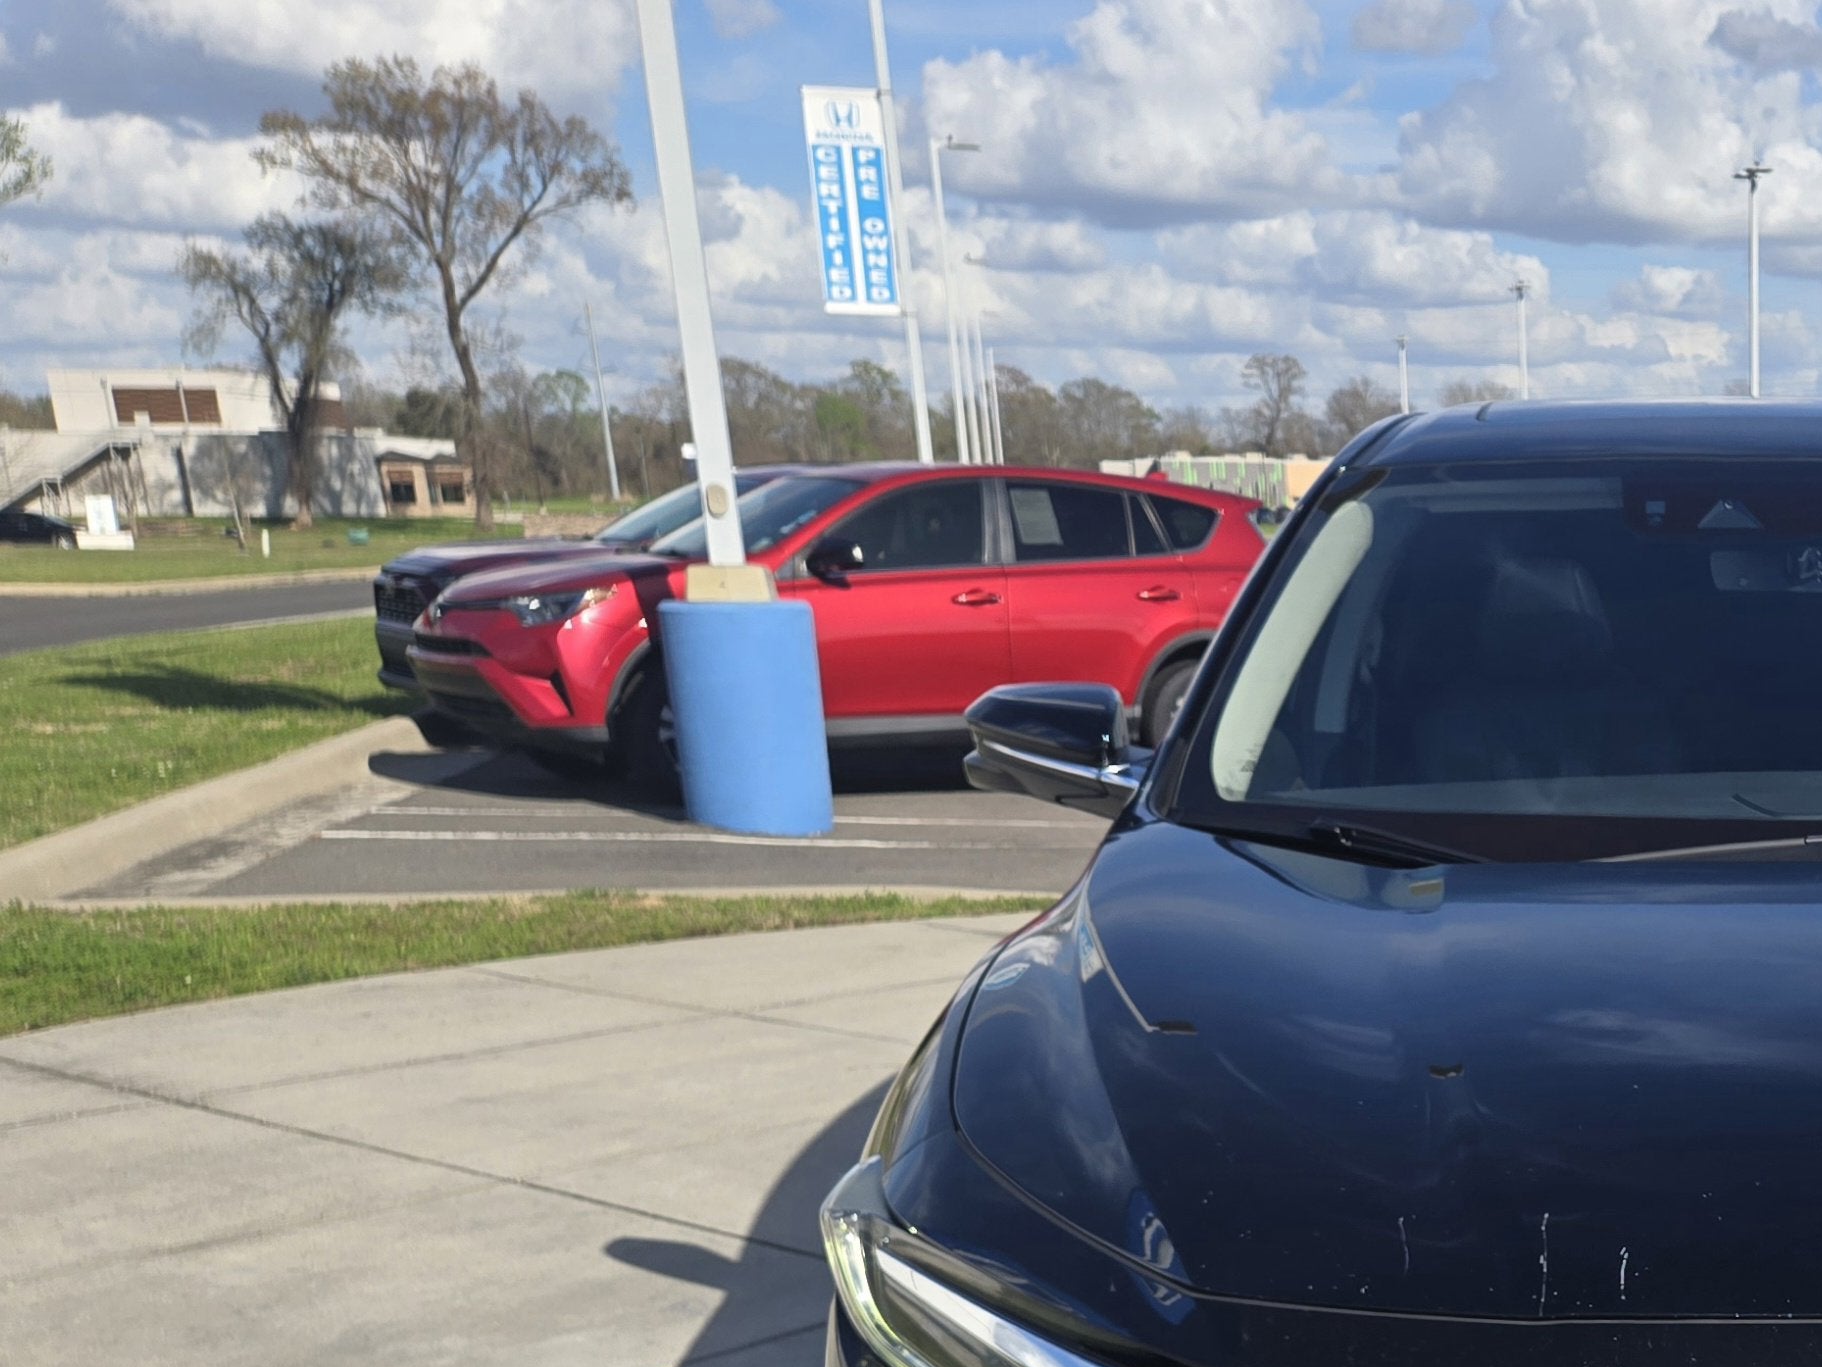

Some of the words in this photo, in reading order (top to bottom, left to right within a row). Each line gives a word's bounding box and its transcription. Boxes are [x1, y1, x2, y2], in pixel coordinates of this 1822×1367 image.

[858, 148, 880, 199] PRE
[815, 146, 852, 300] CERTIFIED
[862, 217, 891, 300] OWNED
